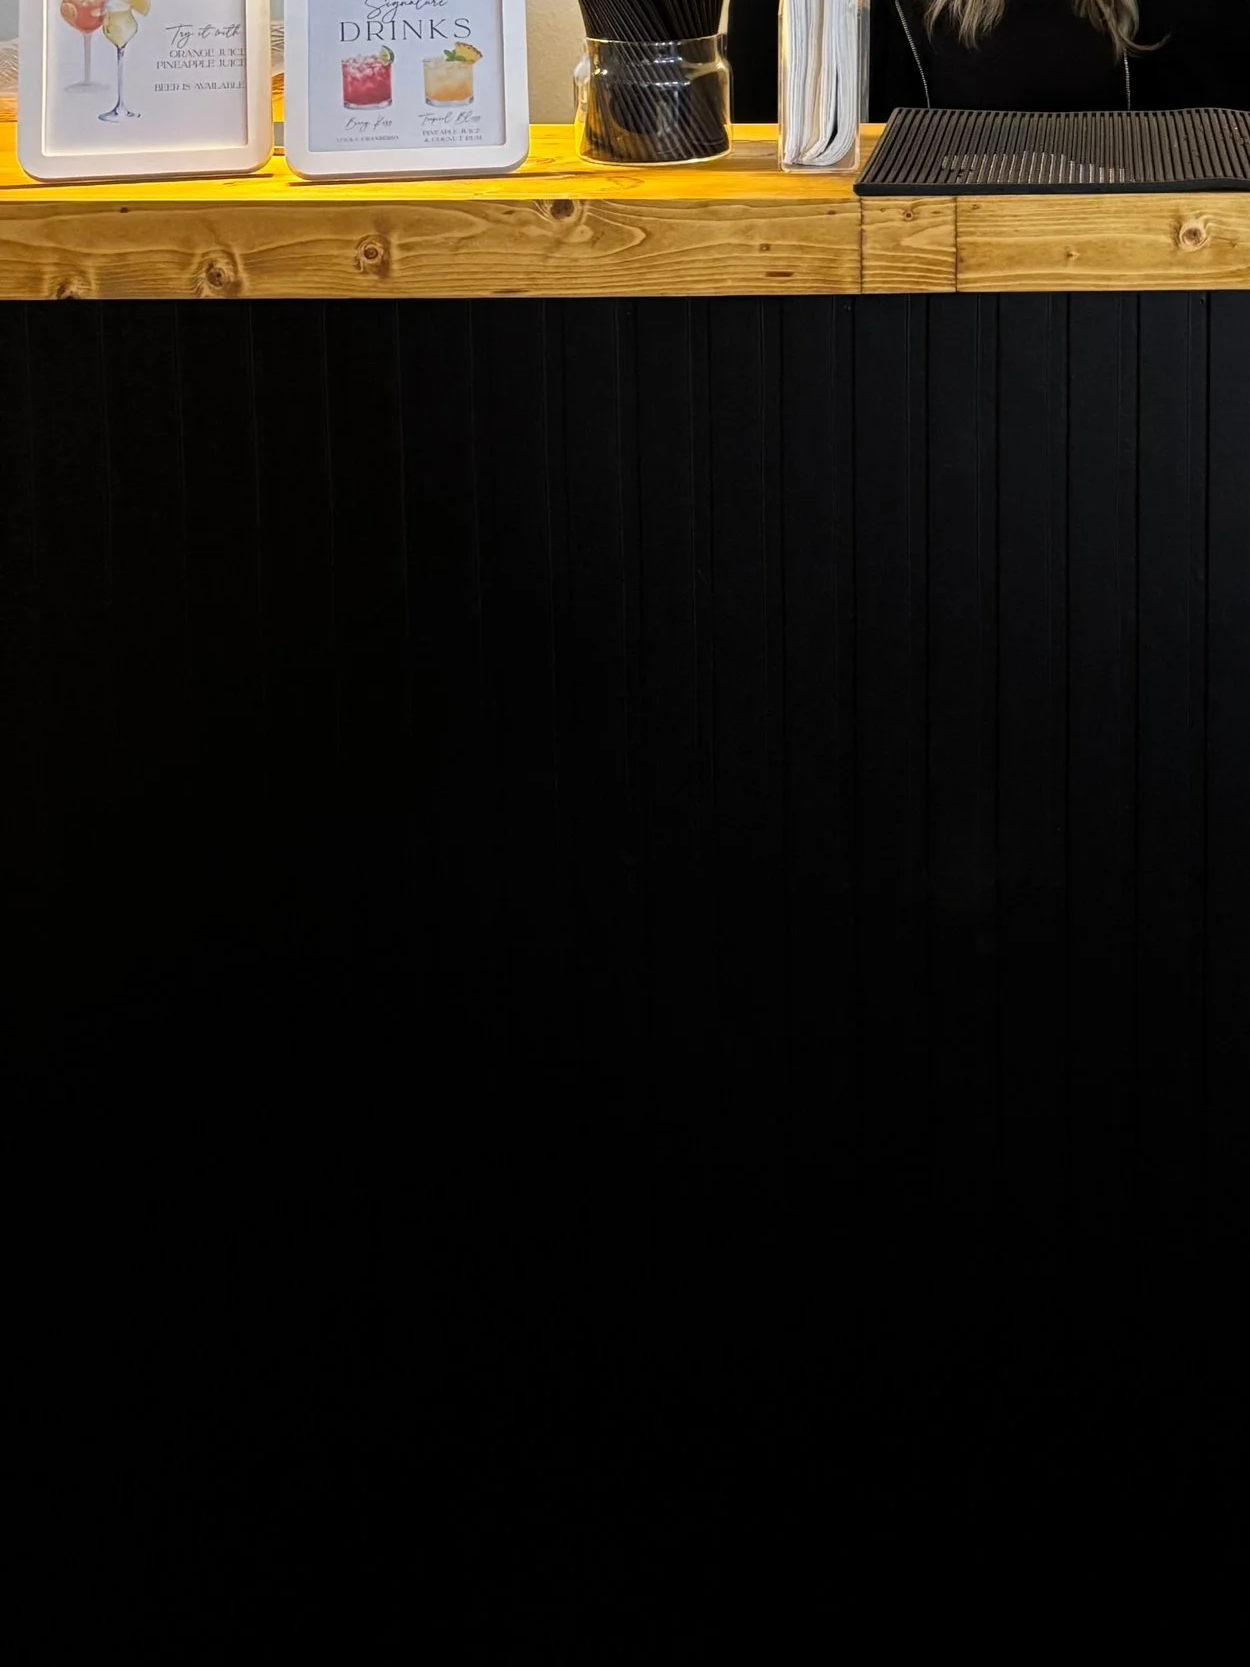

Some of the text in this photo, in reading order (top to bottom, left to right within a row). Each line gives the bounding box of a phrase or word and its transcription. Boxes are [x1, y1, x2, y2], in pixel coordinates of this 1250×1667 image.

[340, 18, 472, 42] DRINKS
[165, 23, 241, 49] Try it with
[169, 48, 215, 58] ORANGE
[156, 59, 215, 70] PINEAPPLE
[154, 83, 180, 92] BEER
